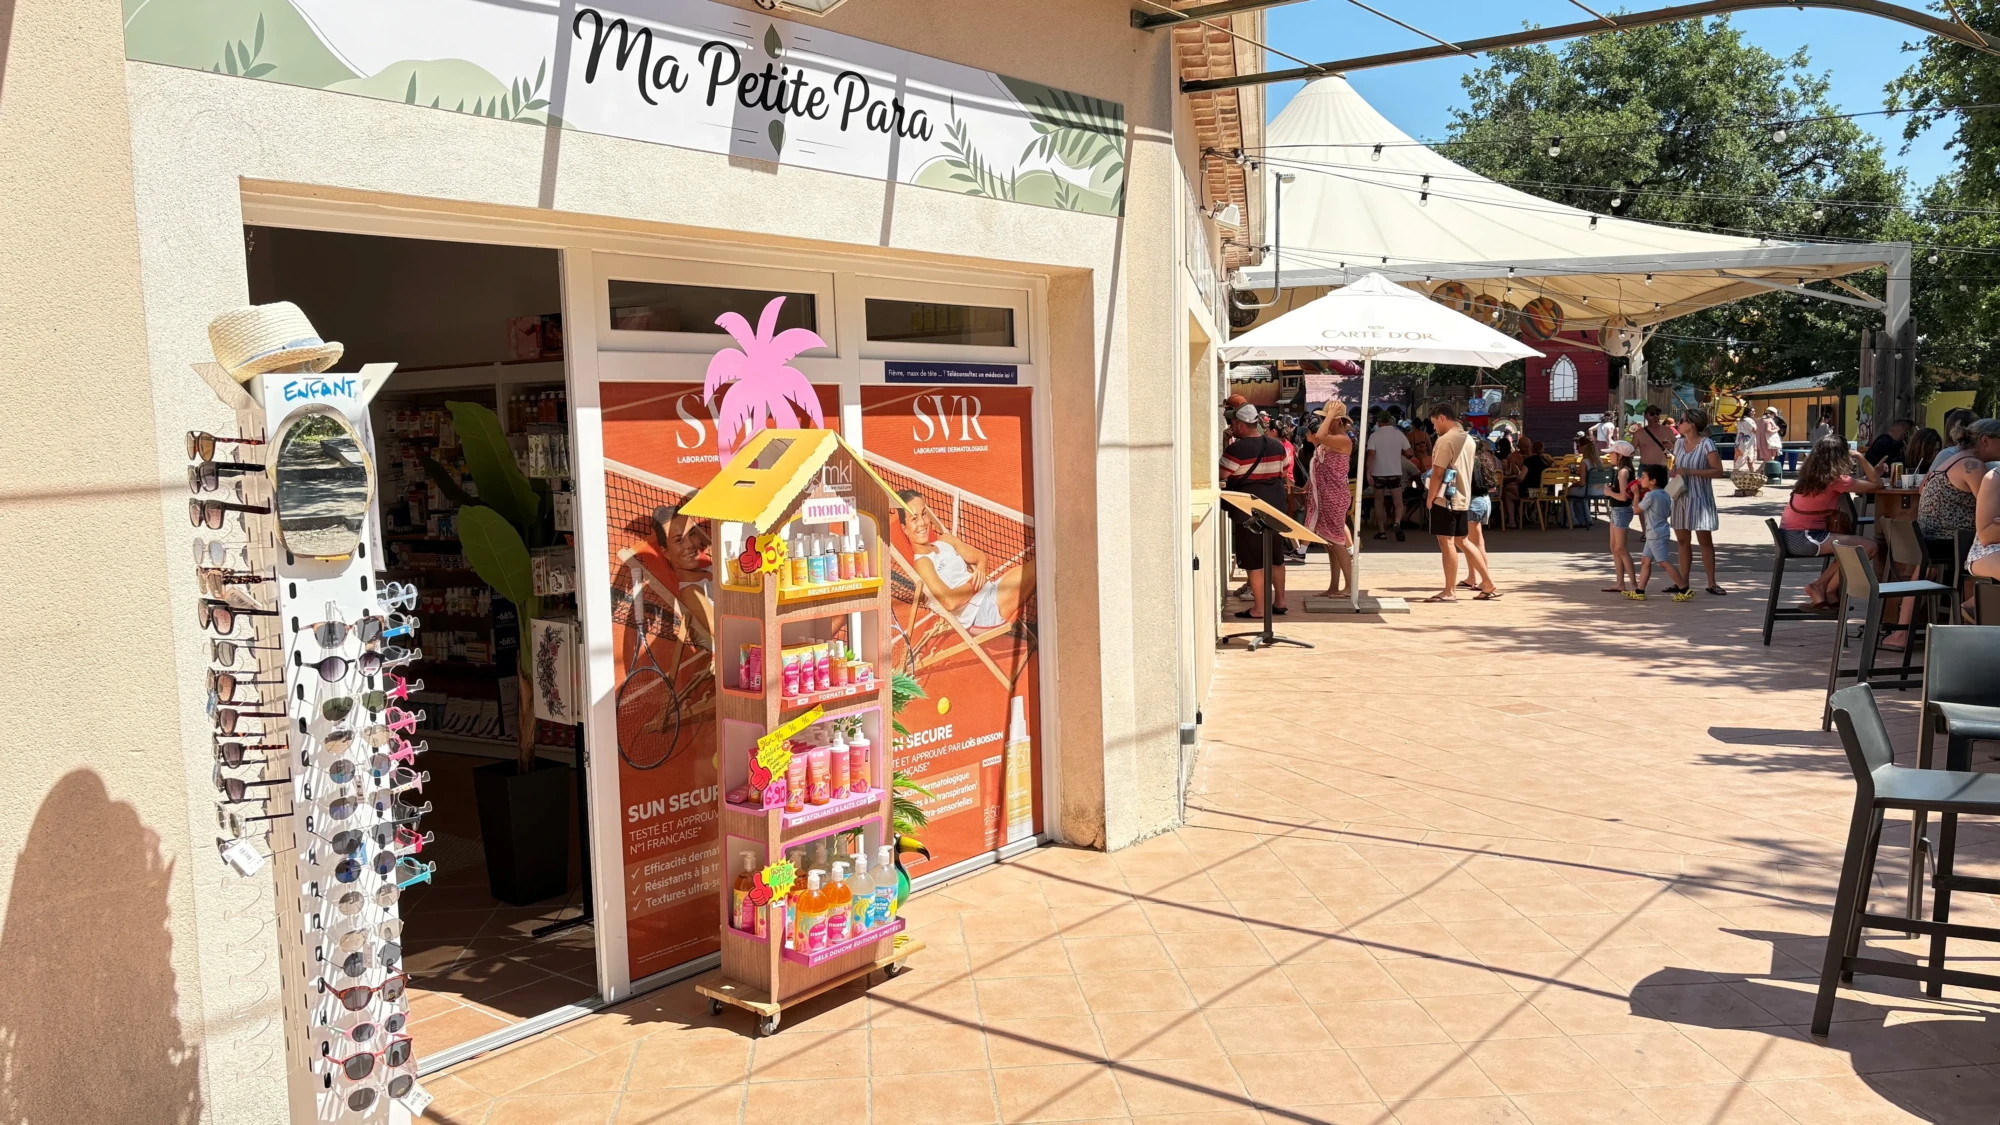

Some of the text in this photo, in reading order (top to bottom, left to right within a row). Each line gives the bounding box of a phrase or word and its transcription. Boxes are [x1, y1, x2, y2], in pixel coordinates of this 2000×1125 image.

[572, 8, 934, 142] Ma Petite Para
[1321, 330, 1442, 342] CARTE D'OR
[920, 369, 927, 377] de
[283, 376, 356, 402] ENFANT
[912, 395, 988, 442] SVR
[914, 445, 988, 454] LABORATOIRE DERMATOLOGIQUE
[823, 459, 852, 484] mkl
[808, 583, 863, 596] BRUMES PARFUMÉES
[819, 690, 844, 700] FORMATS
[906, 724, 952, 748] SECURE
[901, 756, 910, 766] ET
[912, 746, 947, 763] APPROUVÉ
[948, 743, 961, 754] PAR
[962, 738, 976, 750] LOÏS
[977, 731, 1004, 745] BOISSON
[984, 757, 1001, 765] NOUVEAU
[628, 798, 665, 823] SUN
[629, 823, 660, 842] TESTÉ
[662, 820, 674, 833] ET
[644, 855, 687, 876] Efficacité
[645, 871, 692, 892] Résistants
[694, 868, 700, 878] à
[702, 865, 709, 875] la
[646, 889, 686, 908] Textures
[813, 923, 902, 963] GELS DOUCHE ÉDITIONS LIMITÉES
